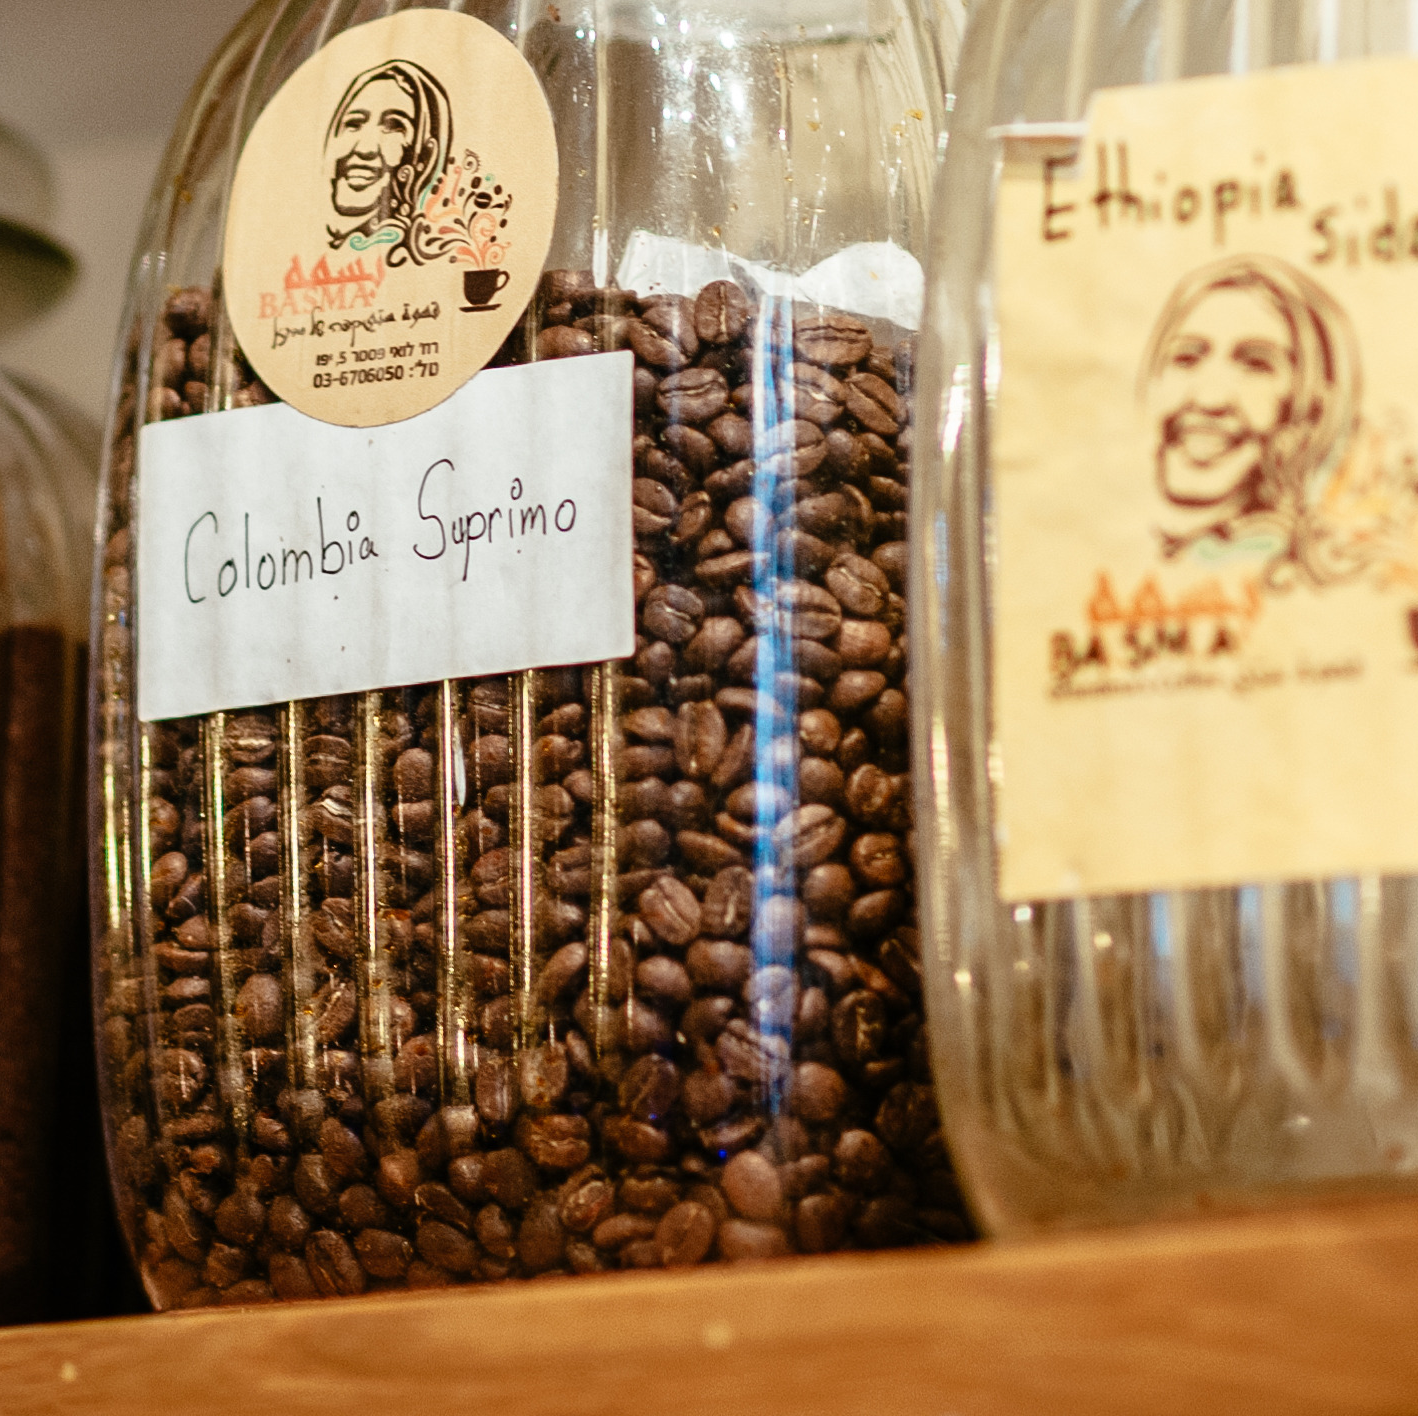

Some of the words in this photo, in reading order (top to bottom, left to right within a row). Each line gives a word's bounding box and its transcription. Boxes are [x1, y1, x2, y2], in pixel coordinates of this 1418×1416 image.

[1042, 139, 1301, 249] Ethiopia
[257, 282, 374, 320] BASMA
[313, 365, 405, 389] 03-6706050
[183, 496, 379, 604] Colombia
[413, 458, 578, 582] Suprimo
